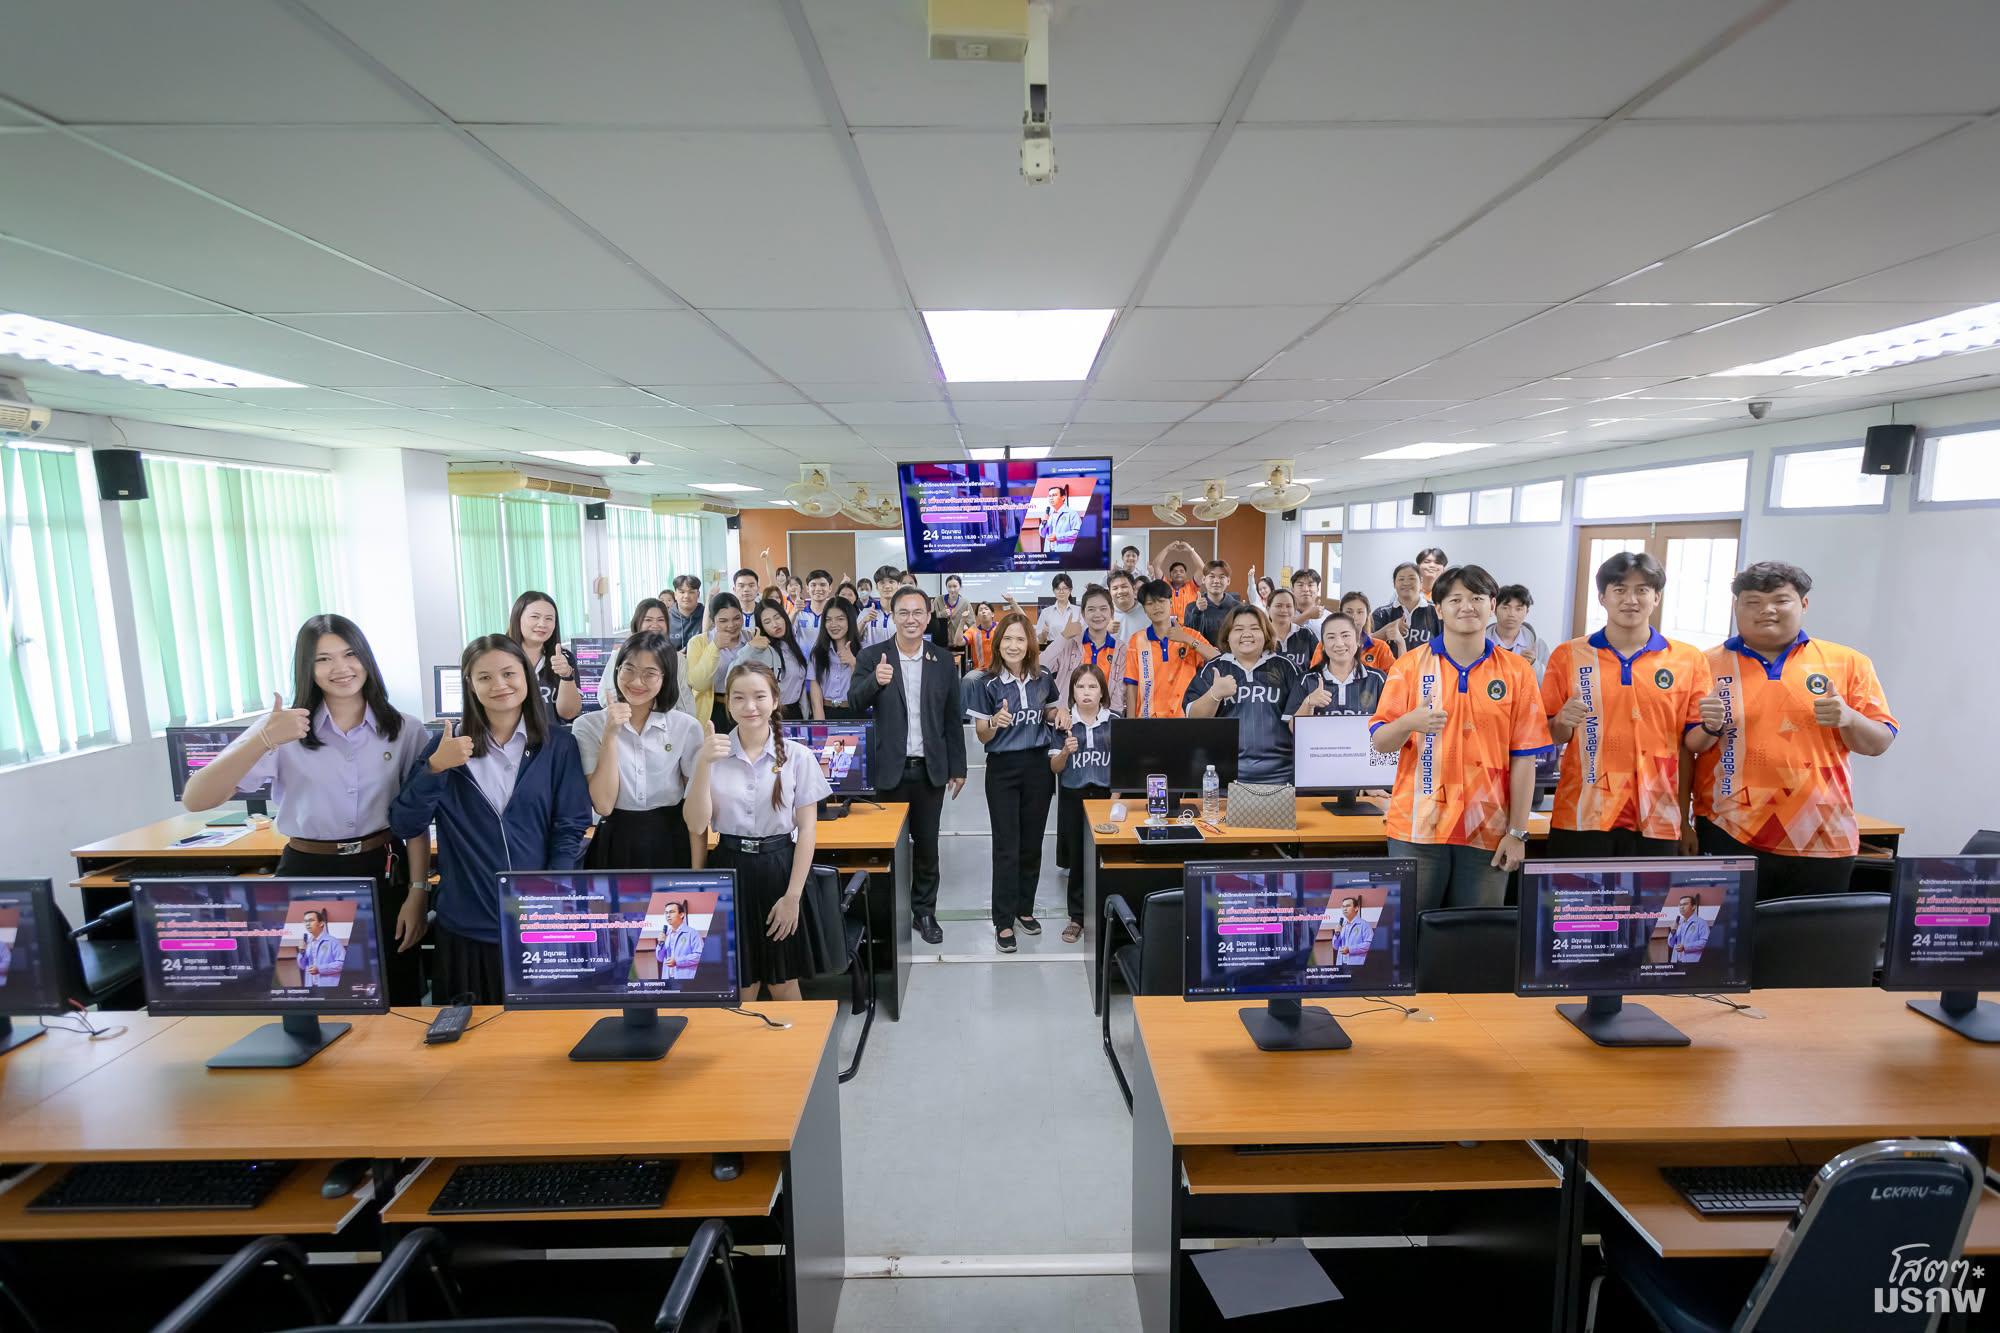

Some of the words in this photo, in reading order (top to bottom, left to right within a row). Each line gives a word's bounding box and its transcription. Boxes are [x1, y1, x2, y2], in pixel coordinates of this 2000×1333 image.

[923, 530, 939, 540] 24
[1072, 751, 1111, 769] KPRU
[1553, 939, 1568, 950] 24
[1912, 934, 1931, 946] 24
[1218, 942, 1234, 953] 24
[522, 952, 541, 964] 24
[162, 959, 182, 971] 24
